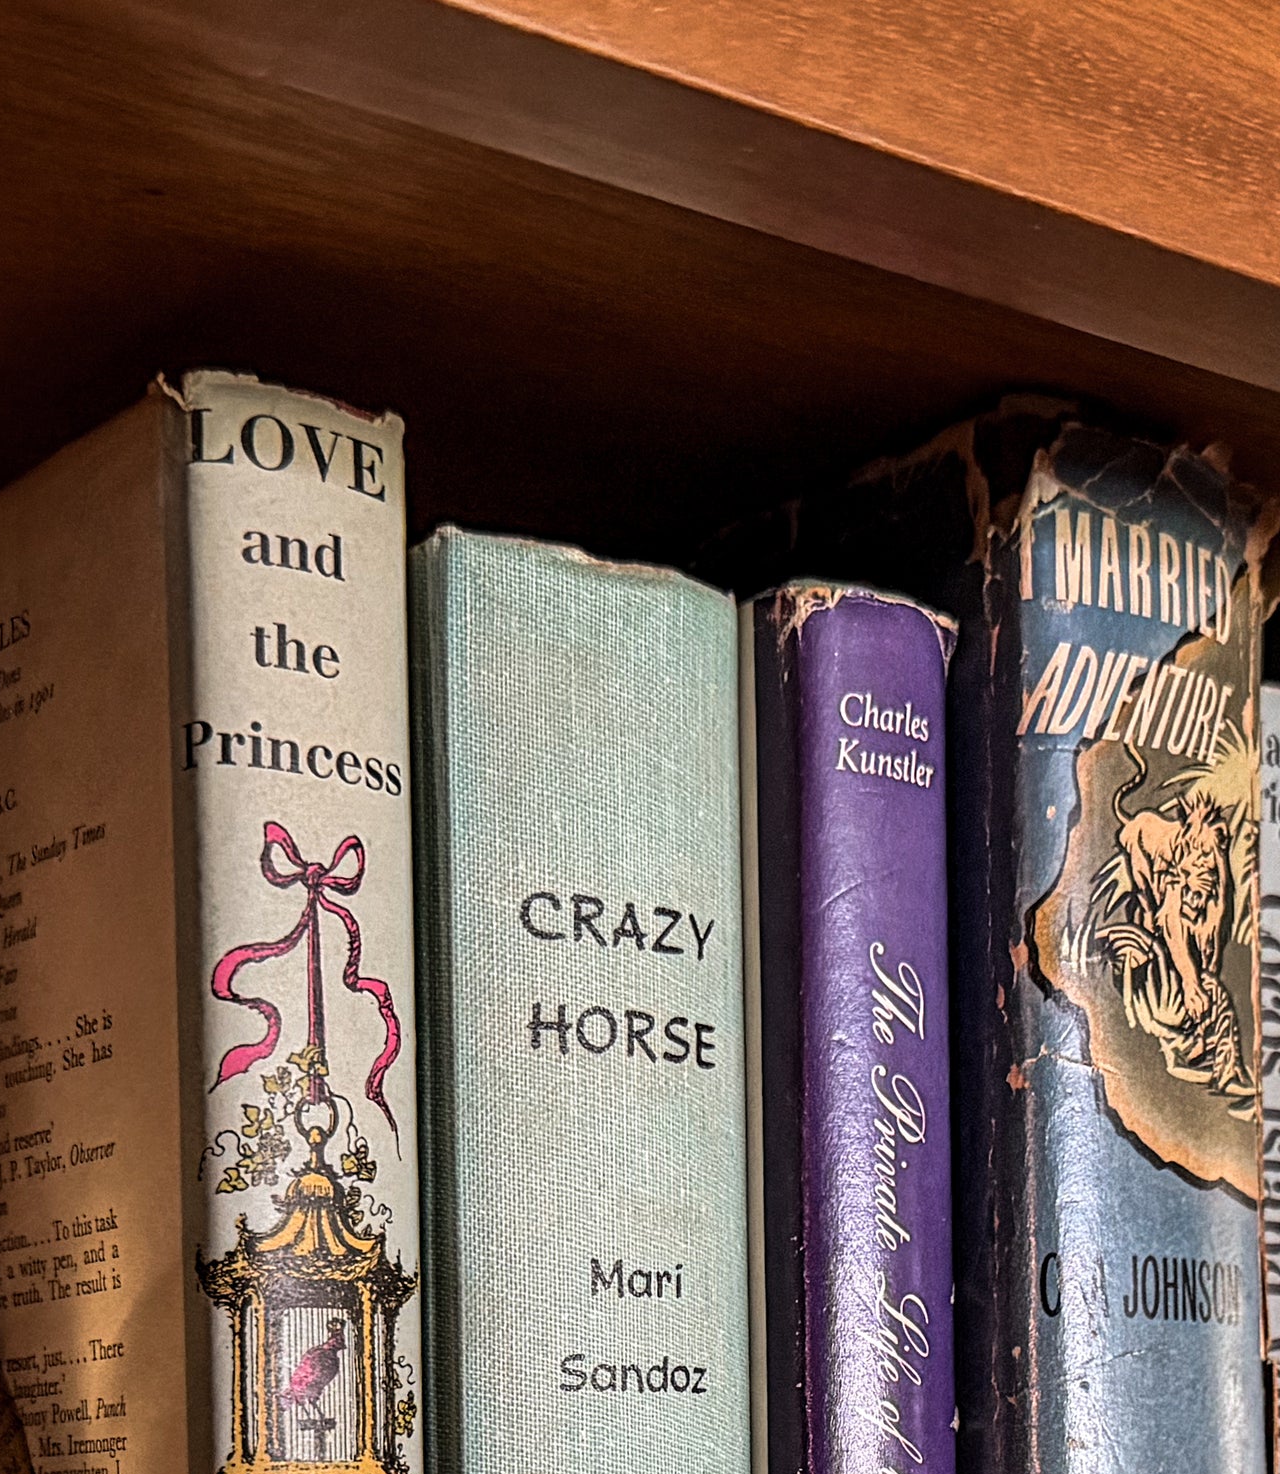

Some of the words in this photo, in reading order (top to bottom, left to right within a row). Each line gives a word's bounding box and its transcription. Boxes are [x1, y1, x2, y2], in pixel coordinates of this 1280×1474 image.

[189, 408, 387, 502] LOVE
[241, 528, 346, 582] and
[1053, 508, 1233, 646] MARRIED
[250, 622, 340, 679] the
[839, 688, 929, 742] Charles
[1015, 641, 1234, 766] ADVENTURE
[183, 719, 403, 797] Princess
[835, 737, 935, 789] Kunstler
[72, 822, 108, 851] Times
[520, 891, 716, 962] CRAZY
[869, 941, 925, 1046] The
[75, 1013, 99, 1039] She
[101, 1008, 114, 1032] is
[528, 1002, 717, 1070] HORSE
[62, 1047, 86, 1072] She
[90, 1039, 114, 1065] has
[24, 1150, 67, 1181] Taylor,
[69, 1140, 118, 1168] Observer
[870, 1065, 926, 1252] Private
[52, 1219, 70, 1243] To
[72, 1213, 93, 1240] this
[95, 1208, 119, 1234] task
[6, 1265, 15, 1281] a
[19, 1256, 48, 1281] witty
[53, 1253, 79, 1279] pen,
[83, 1239, 106, 1266] and
[111, 1243, 121, 1260] a
[47, 1278, 72, 1302] The
[75, 1270, 108, 1297] result
[111, 1267, 123, 1291] is
[589, 1257, 684, 1300] Mari
[1123, 1253, 1244, 1328] JOHNSON
[88, 1338, 125, 1362] There
[859, 1270, 930, 1387] Life
[560, 1351, 709, 1396] Sandoz
[51, 1399, 93, 1425] Powell,
[95, 1394, 127, 1420] Punch
[856, 1399, 924, 1466] of
[37, 1436, 66, 1459] Mrs.
[67, 1434, 128, 1460] Iremonger
